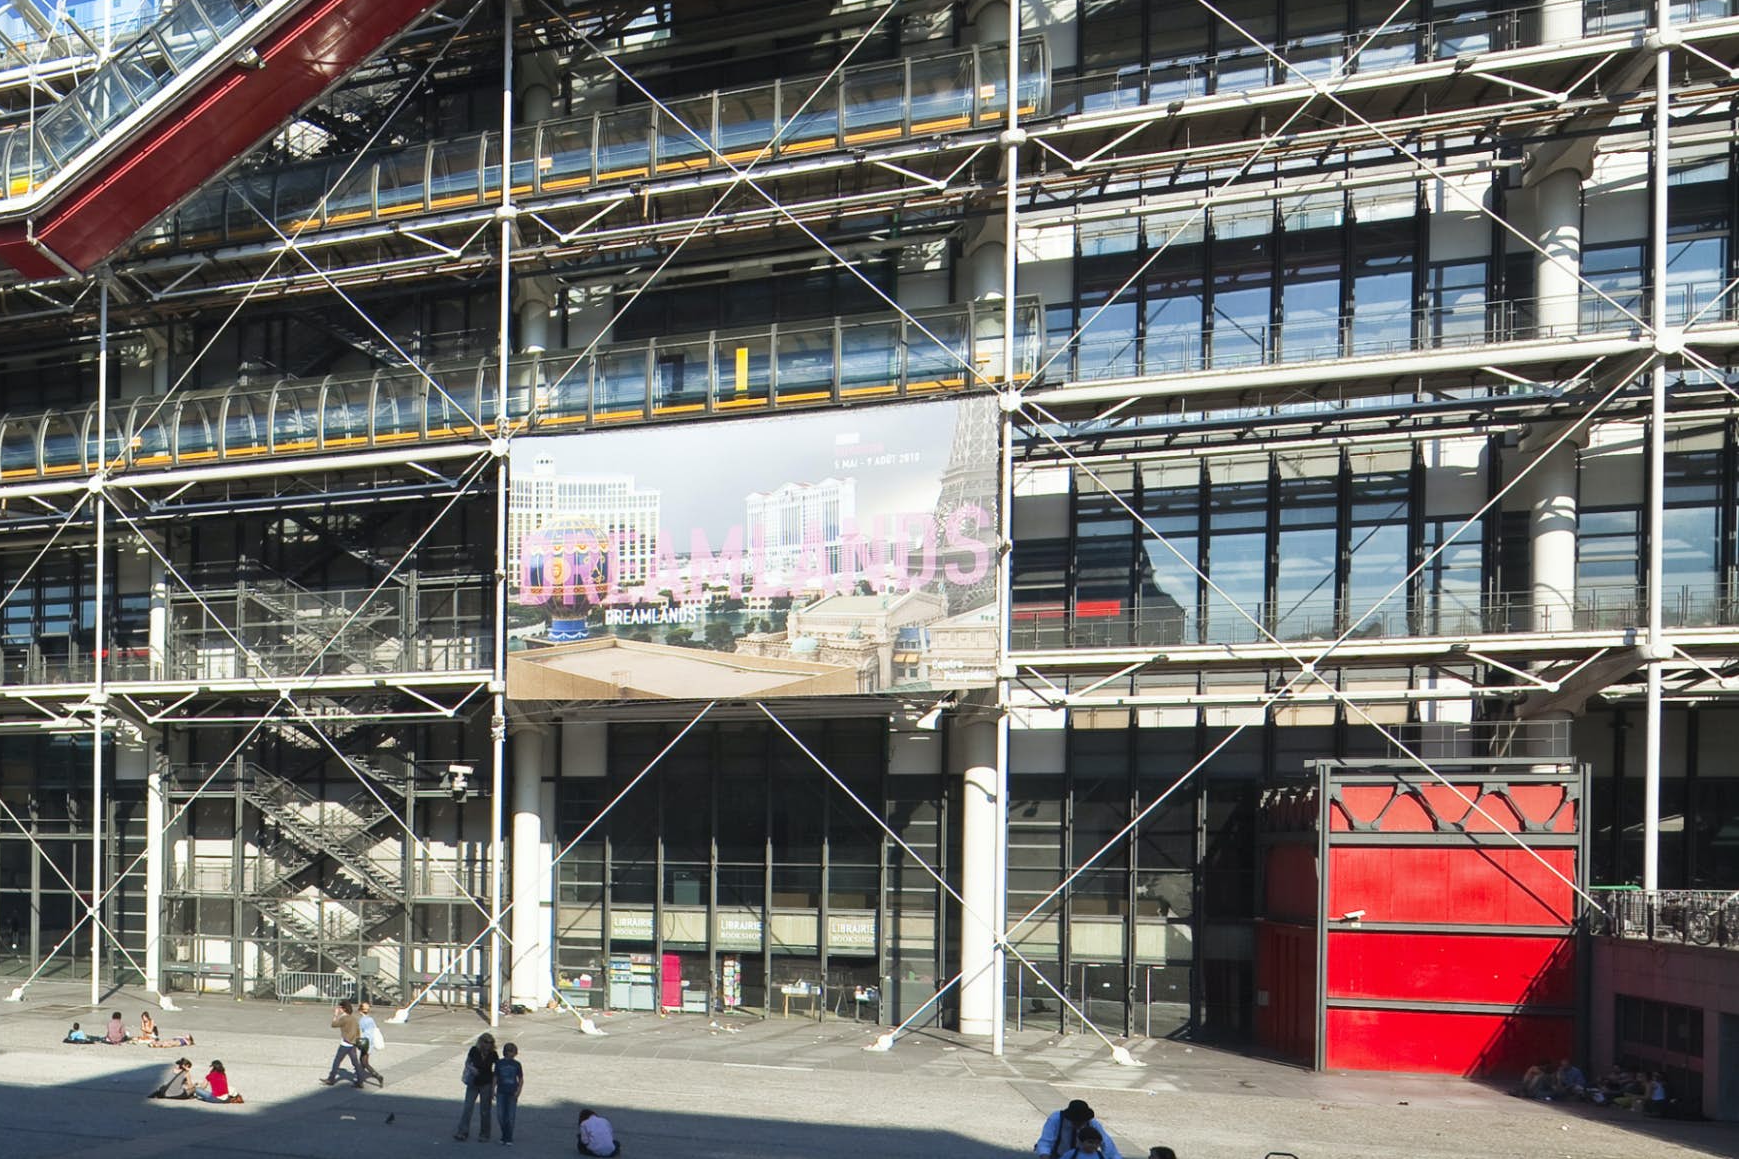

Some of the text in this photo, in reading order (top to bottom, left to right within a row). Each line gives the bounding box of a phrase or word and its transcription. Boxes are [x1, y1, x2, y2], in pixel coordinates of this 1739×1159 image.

[519, 504, 991, 605] DREAMLANDS
[605, 606, 697, 625] DREAMLANDS
[614, 917, 653, 928] LIBRAIRIE
[721, 919, 762, 930] LIBRAIRIE
[832, 923, 875, 934] LIBRAIRIE
